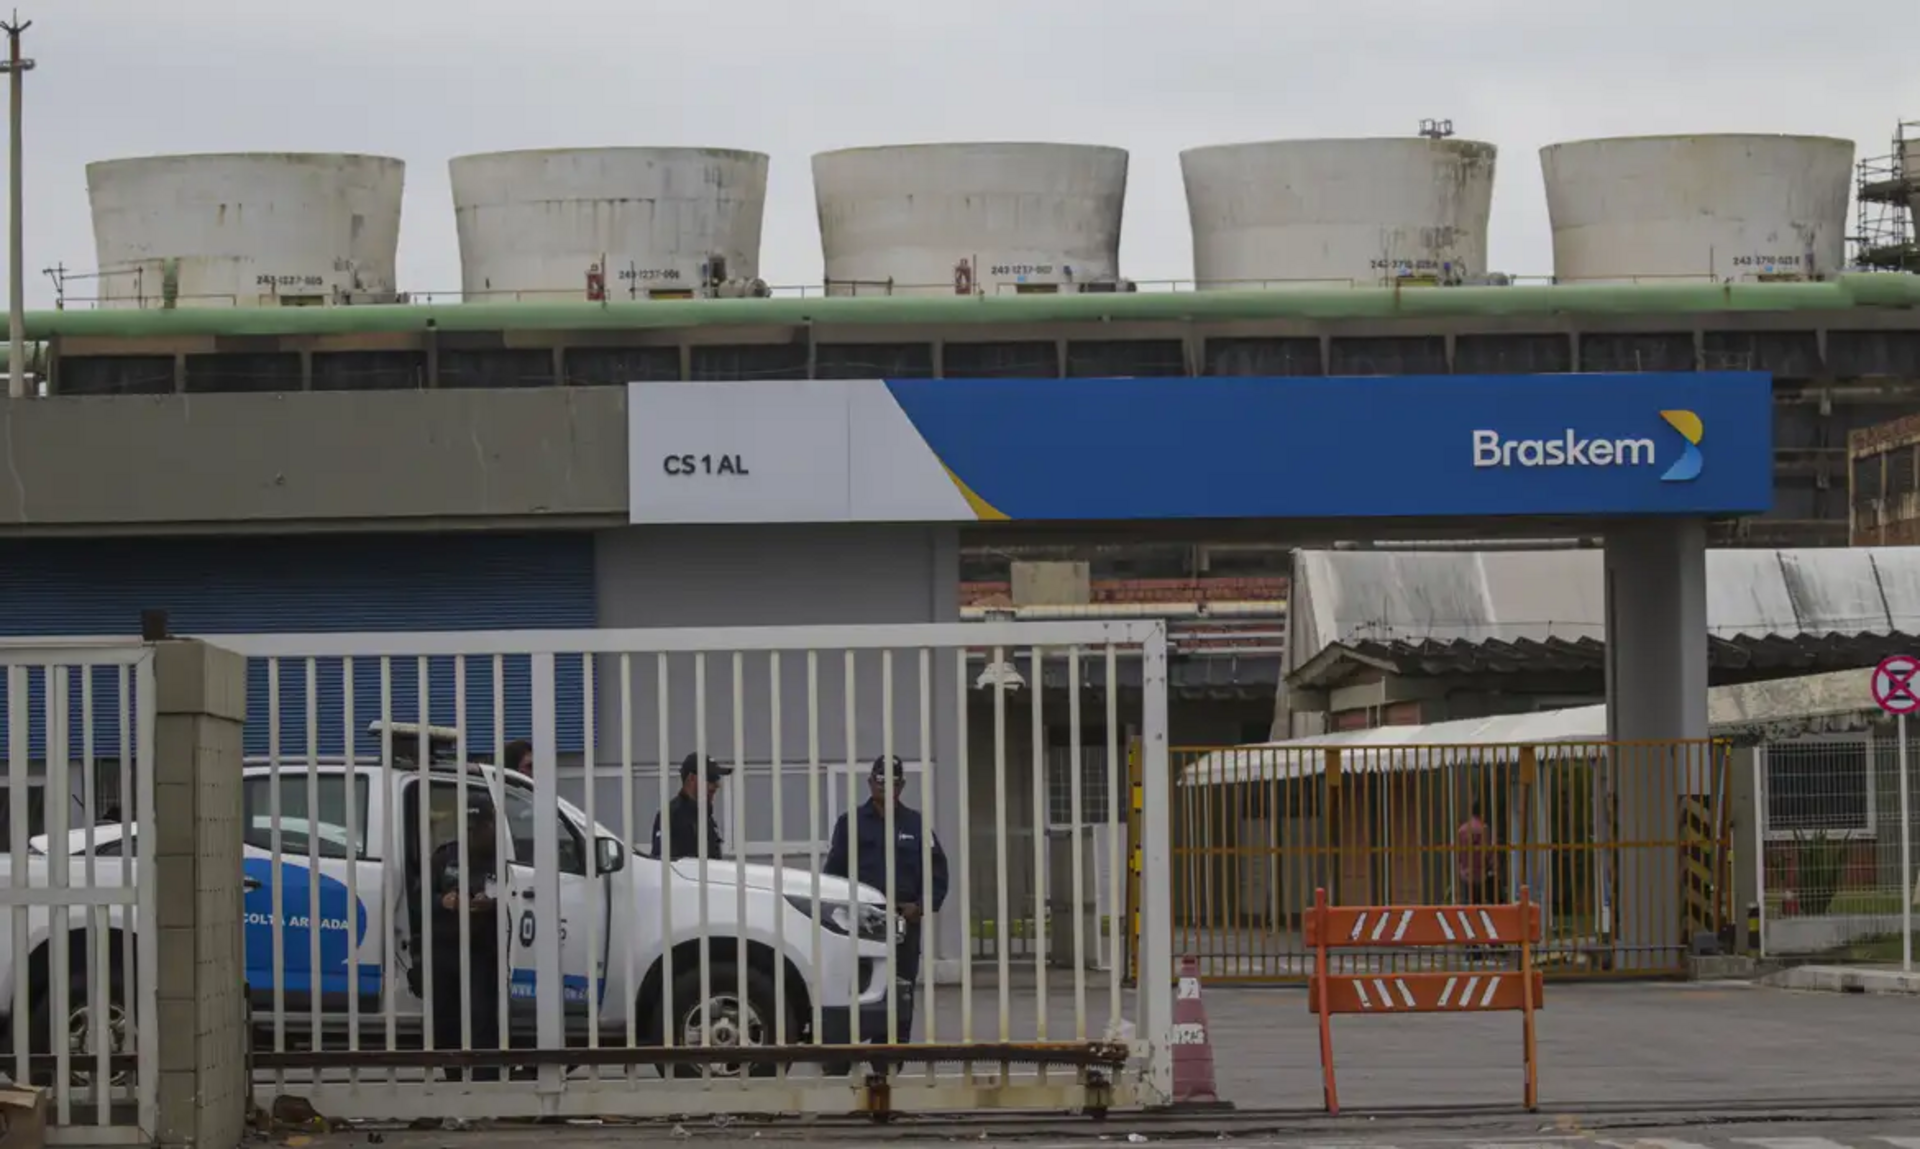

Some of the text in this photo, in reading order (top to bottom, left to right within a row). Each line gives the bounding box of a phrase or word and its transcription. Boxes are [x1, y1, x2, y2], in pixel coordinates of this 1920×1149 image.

[1473, 428, 1655, 467] Braskem
[663, 453, 749, 475] CS 1 AL
[289, 916, 349, 931] ARADA
